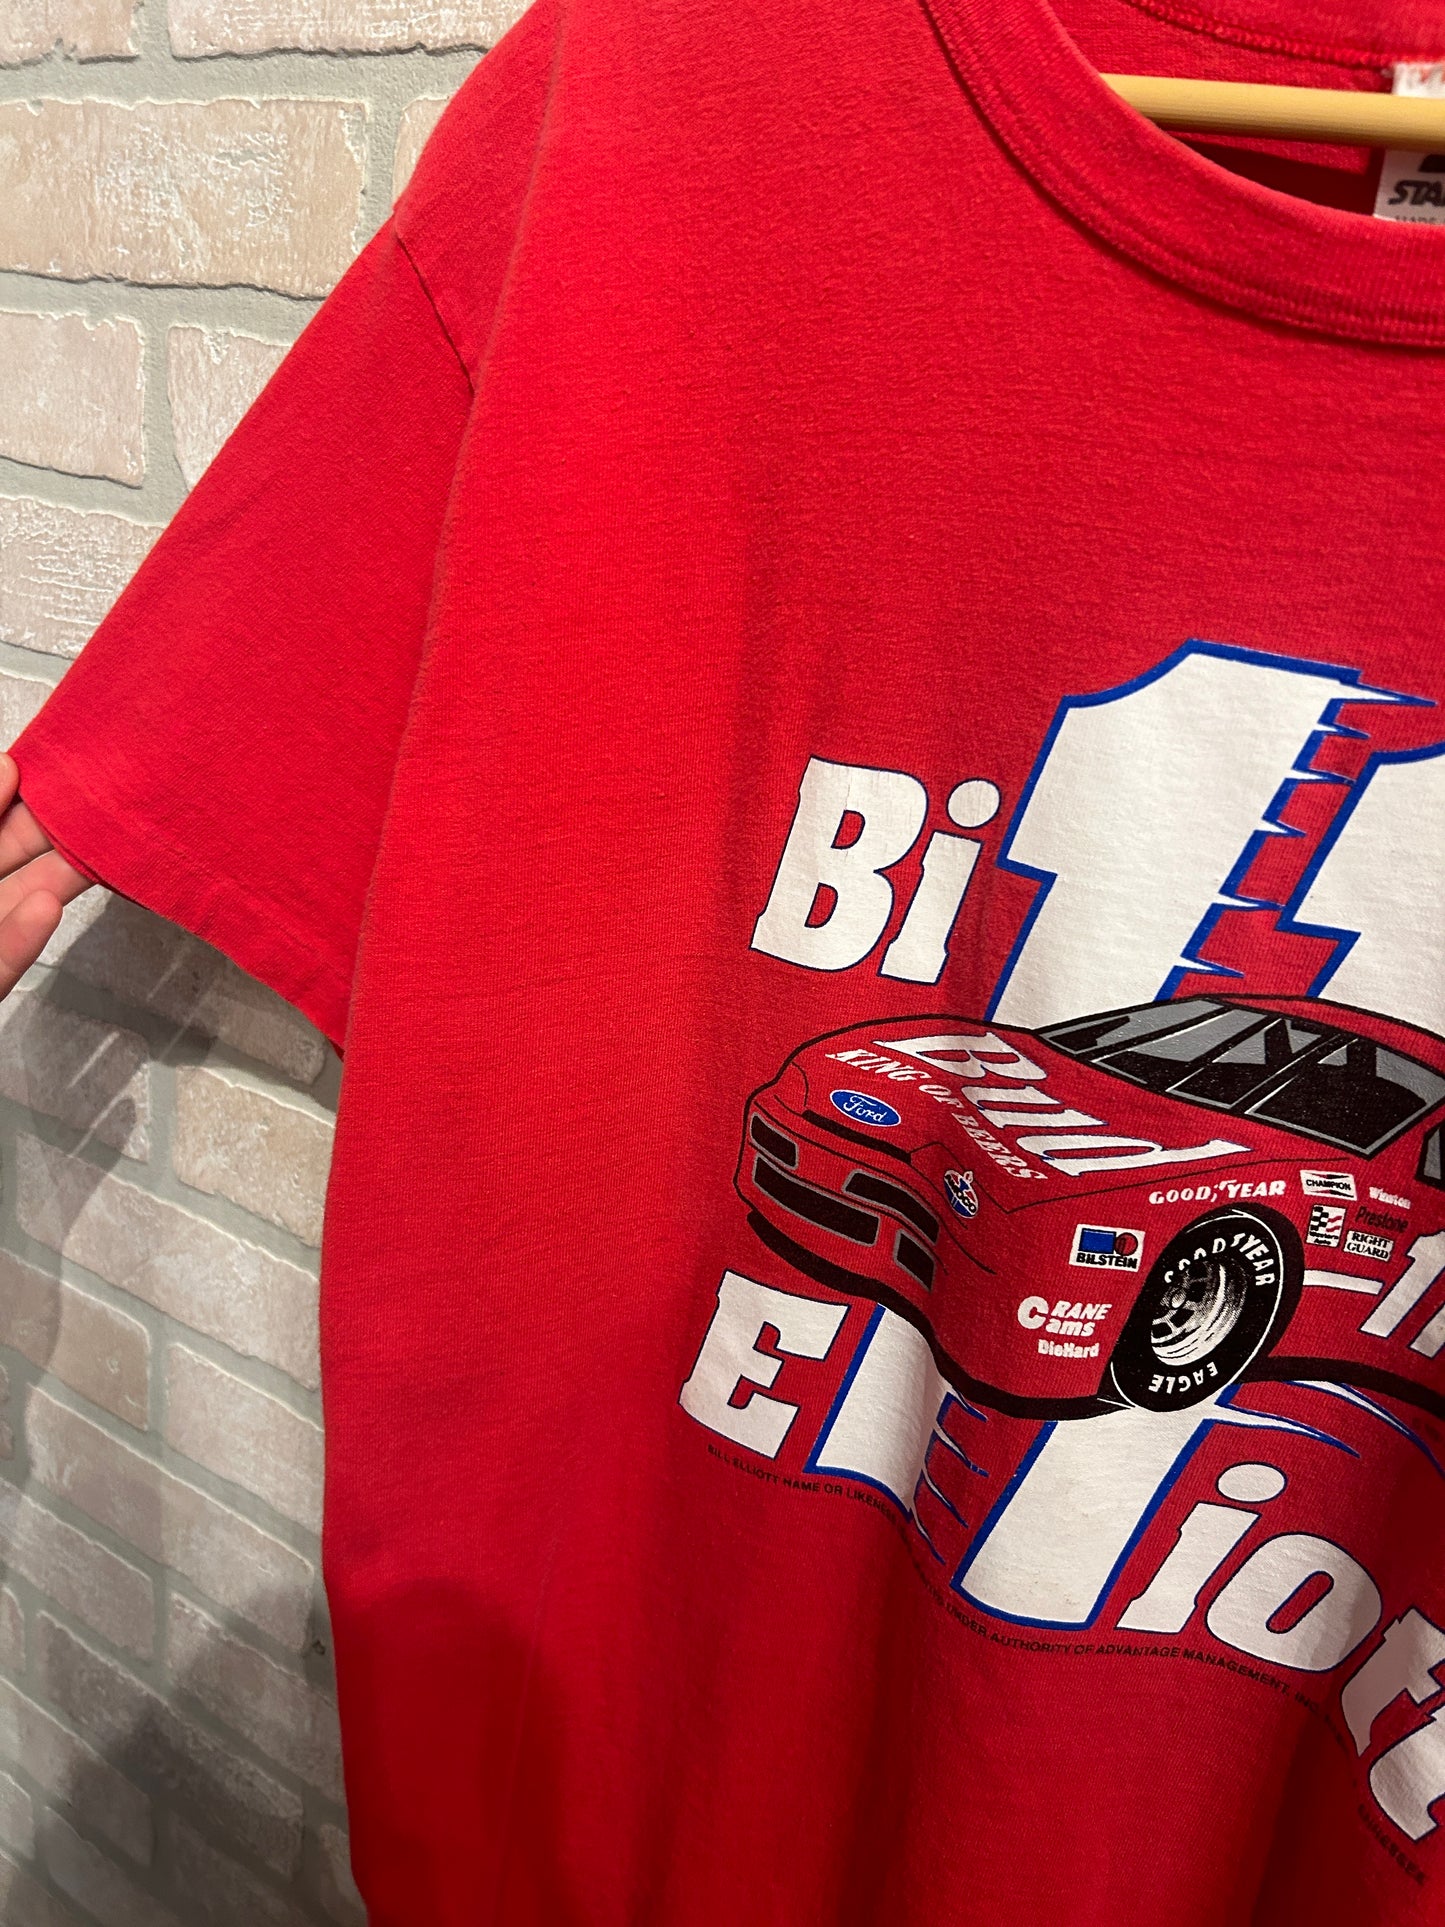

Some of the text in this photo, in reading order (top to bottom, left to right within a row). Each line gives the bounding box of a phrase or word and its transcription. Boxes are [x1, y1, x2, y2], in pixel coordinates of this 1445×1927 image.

[1388, 180, 1445, 206] STA
[825, 1048, 1048, 1180] KING OF BEERS
[843, 1094, 888, 1124] Ford
[873, 1031, 1252, 1177] Bud
[1306, 1178, 1352, 1191] CHAMPION
[1355, 1205, 1409, 1234] Prestone
[1347, 1242, 1389, 1259] GUARD
[1351, 1232, 1391, 1249] RIGHT
[1076, 1252, 1138, 1270] BILSTEIN
[1038, 1338, 1100, 1359] DieHard
[1149, 1361, 1219, 1395] EAGLE
[708, 1444, 731, 1463] BILL
[733, 1457, 779, 1485] ELLIOTT
[783, 1477, 820, 1493] NAME
[823, 1482, 844, 1496] OR
[946, 1602, 989, 1637] UNDER
[988, 1631, 1071, 1656] AUTHORITY
[1072, 1644, 1094, 1656] OF
[1094, 1643, 1179, 1658] ADVANTAGE
